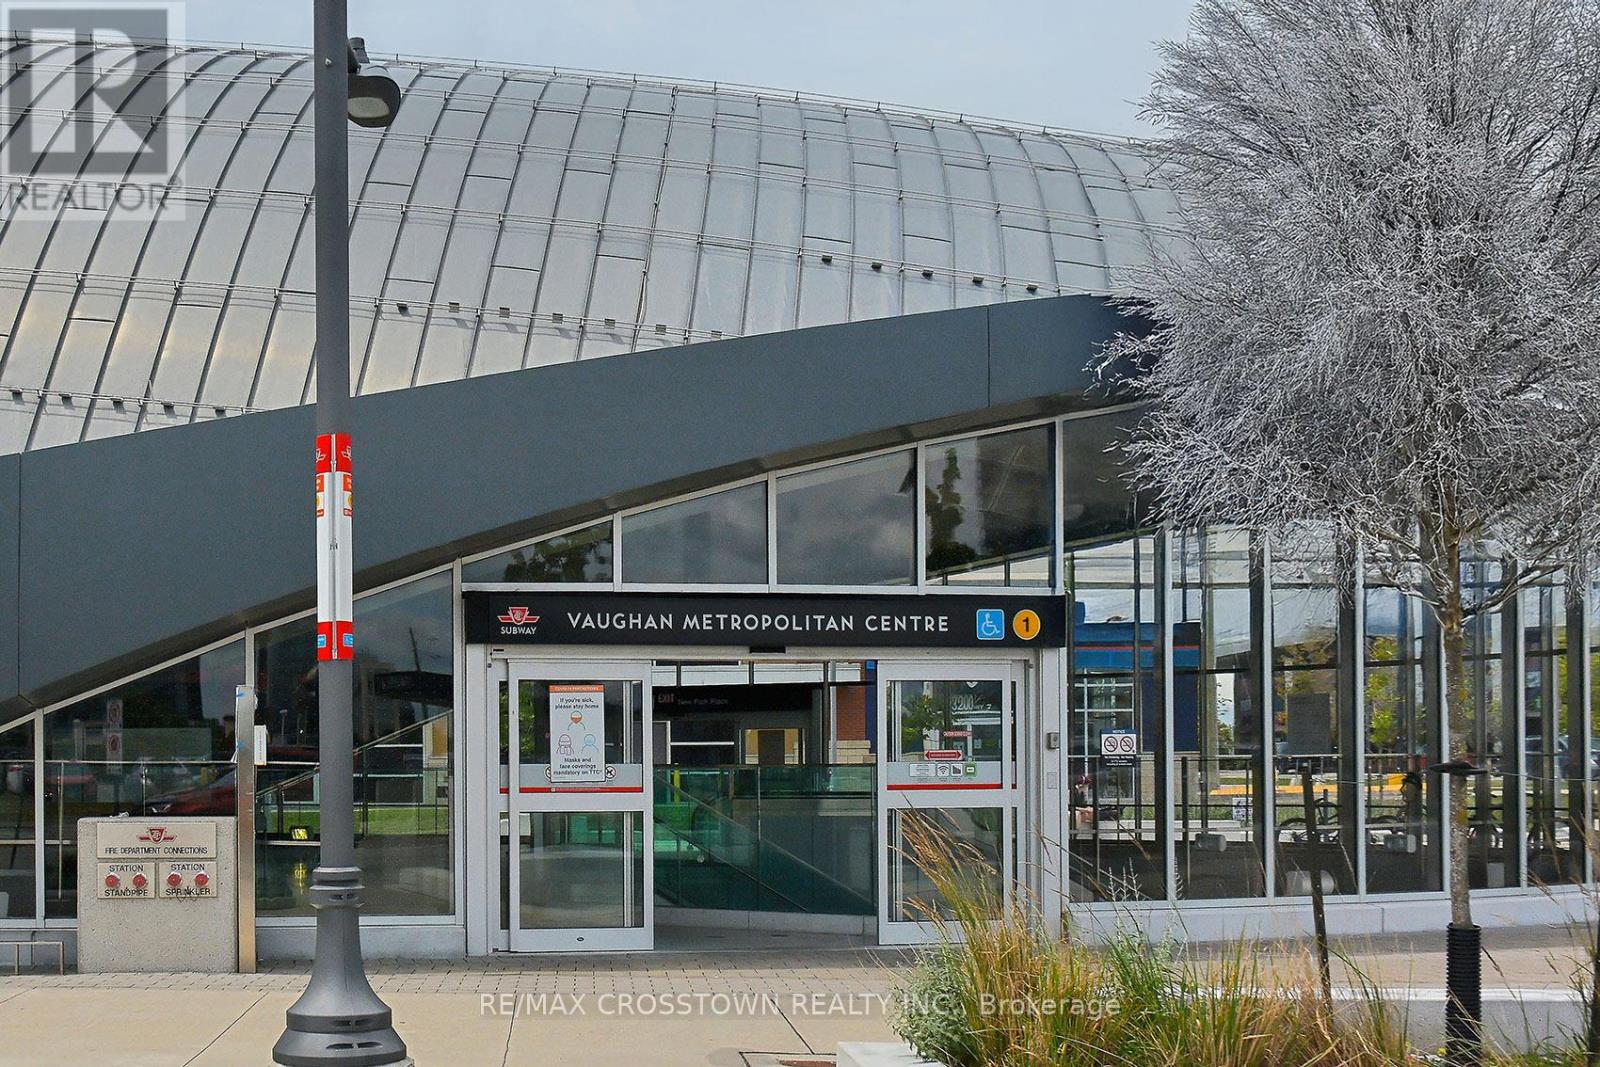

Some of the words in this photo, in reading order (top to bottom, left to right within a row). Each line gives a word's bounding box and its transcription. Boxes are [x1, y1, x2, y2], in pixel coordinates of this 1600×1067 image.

[567, 612, 674, 630] VAUGHAN
[683, 614, 855, 632] METROPOLITAN
[865, 614, 949, 633] CENTRE
[500, 626, 537, 635] SUBWAY
[657, 693, 674, 704] EXIT
[572, 763, 597, 771] coverings
[553, 769, 580, 777] mandatory
[163, 846, 208, 854] CONNECTIONS
[109, 864, 144, 872] STATION
[170, 863, 205, 871] STATION
[104, 888, 149, 897] STANDPIPE
